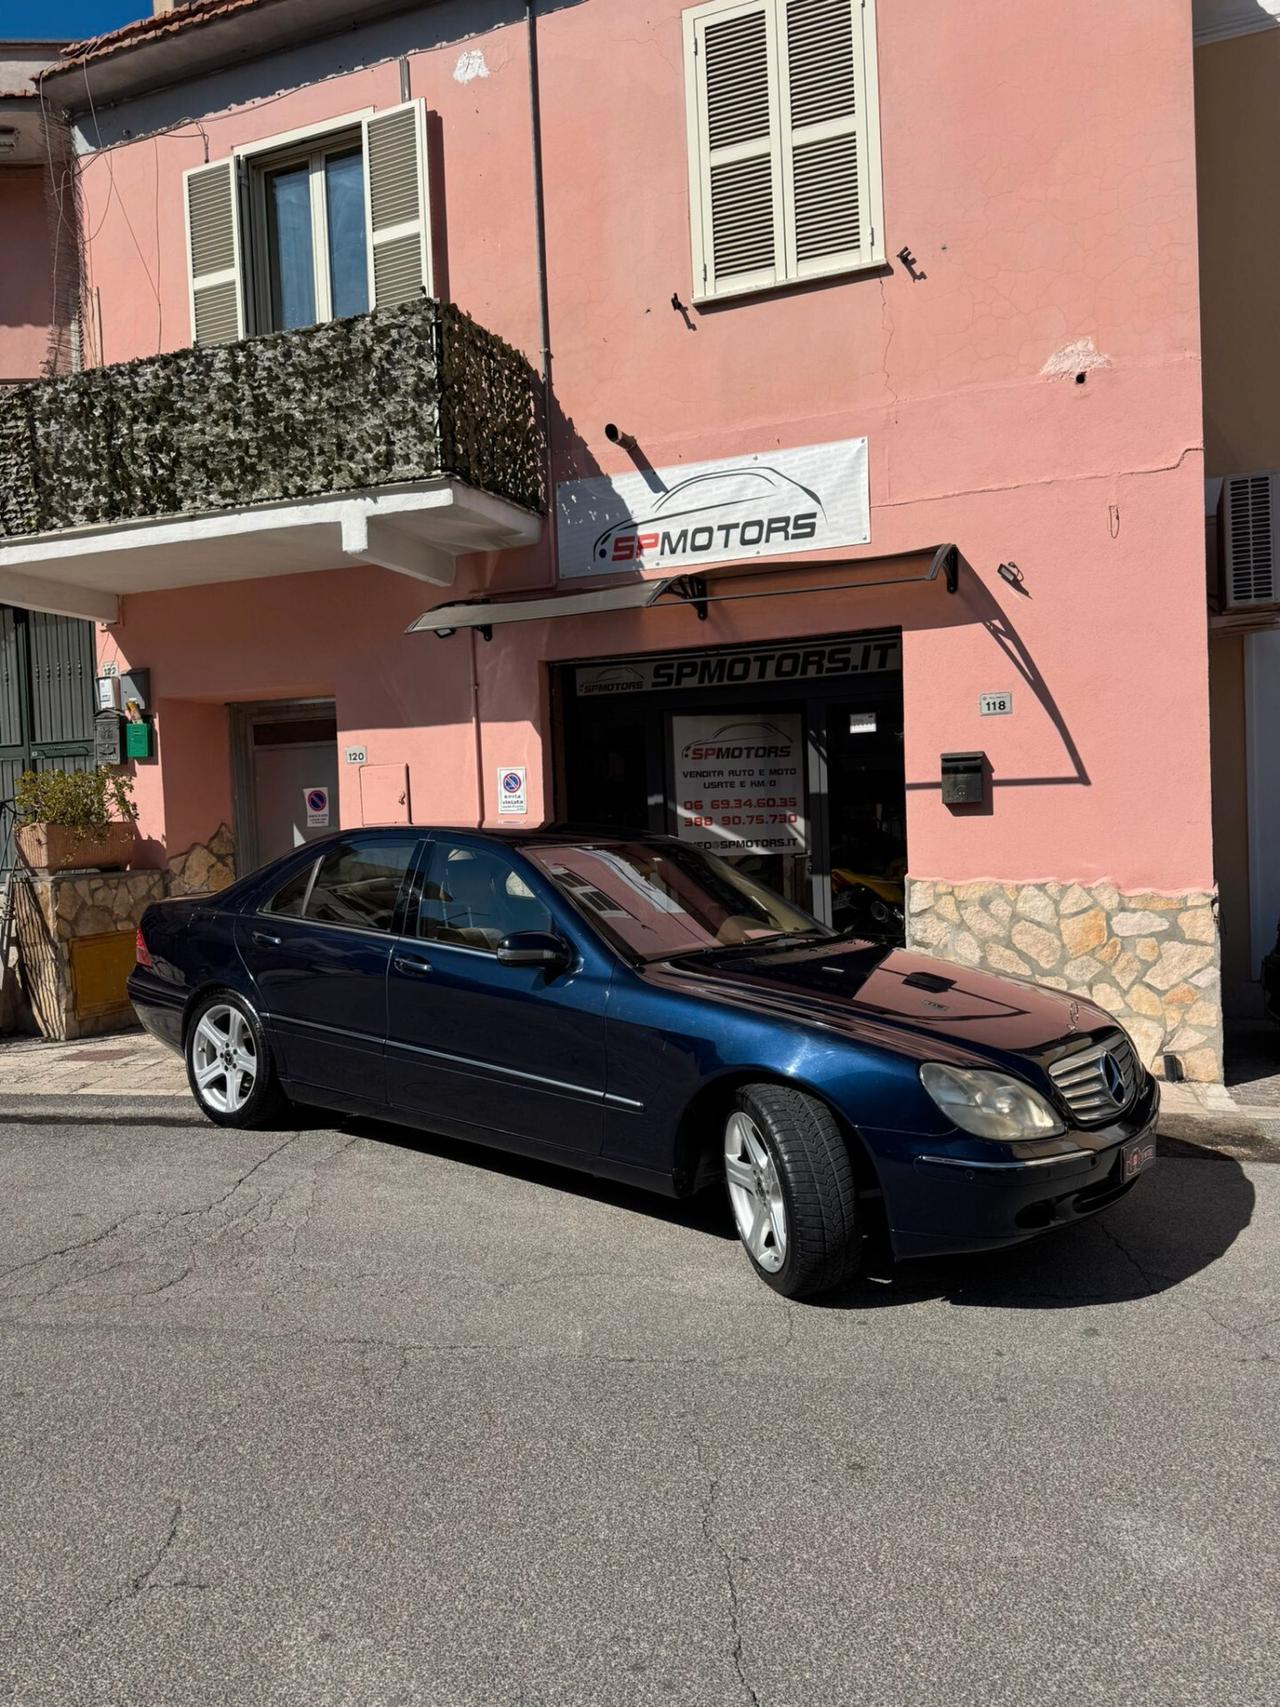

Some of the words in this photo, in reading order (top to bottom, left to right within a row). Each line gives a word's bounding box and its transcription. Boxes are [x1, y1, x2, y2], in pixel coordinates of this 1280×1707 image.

[612, 511, 818, 561] SPMOTORS
[651, 642, 899, 688] SPMOTORS.IT
[583, 680, 644, 694] SPMOTORS
[986, 700, 1006, 711] 118
[348, 752, 365, 761] 120
[690, 745, 792, 761] SPMOTORS
[682, 769, 725, 779] VENDITA
[727, 768, 755, 778] AUTO
[759, 769, 765, 777] E
[768, 767, 797, 777] MOTO
[703, 780, 736, 790] USATE
[740, 780, 746, 788] E
[750, 779, 765, 788] KM
[683, 800, 704, 811] 06
[710, 797, 797, 810] 69.34.60.35
[721, 814, 798, 827] 90.75.730
